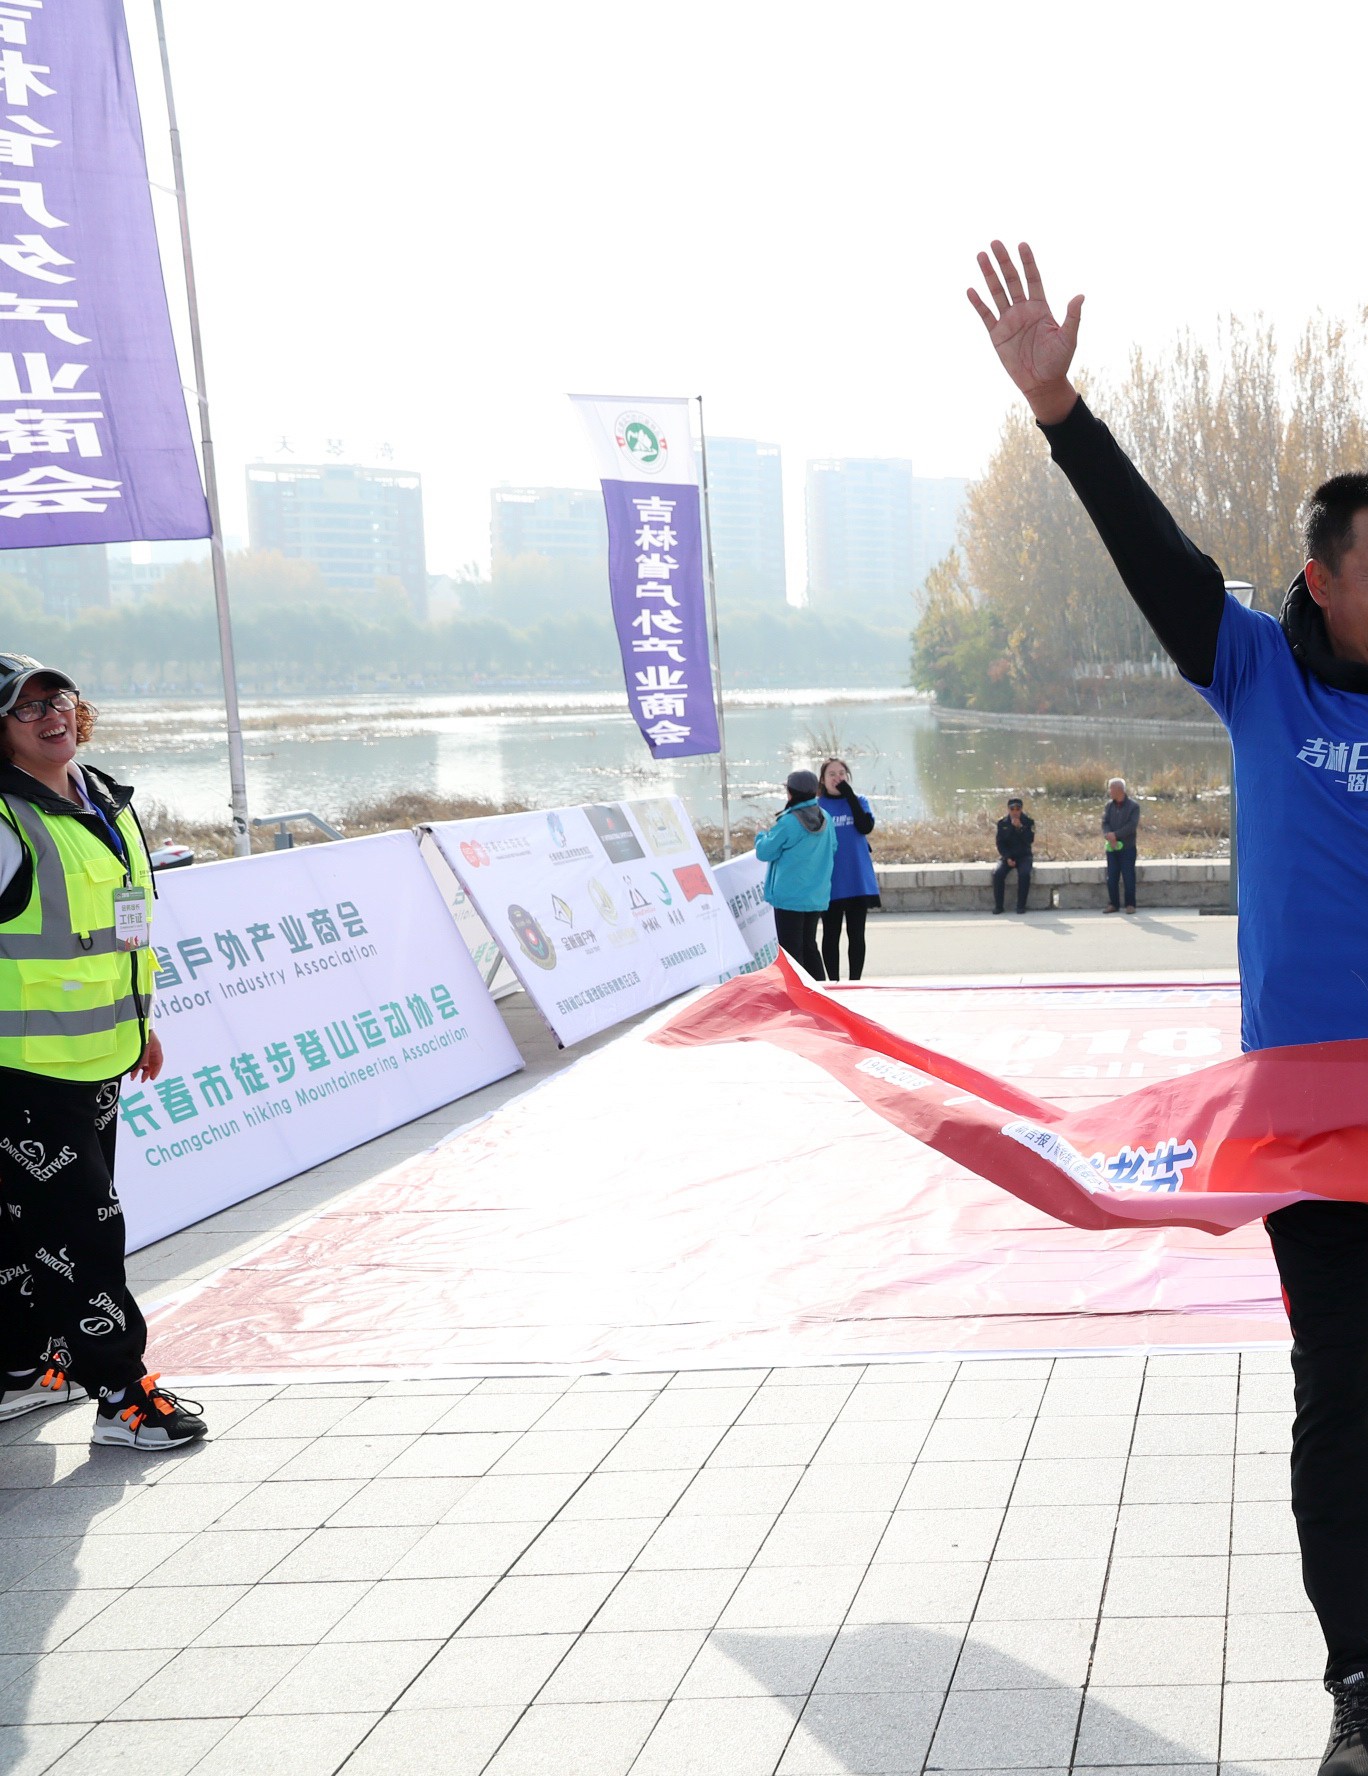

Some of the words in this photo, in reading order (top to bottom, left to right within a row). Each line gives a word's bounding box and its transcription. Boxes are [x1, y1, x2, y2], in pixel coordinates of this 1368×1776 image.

[154, 989, 213, 1019] utdoor
[218, 967, 287, 999] Industry
[294, 942, 378, 978] Association
[119, 983, 460, 1139] 长春市徒步登山运动协会
[145, 1117, 241, 1167] Changchun
[243, 1097, 293, 1128] hiking
[295, 1053, 399, 1107] Mountaineering
[401, 1025, 470, 1063] Association
